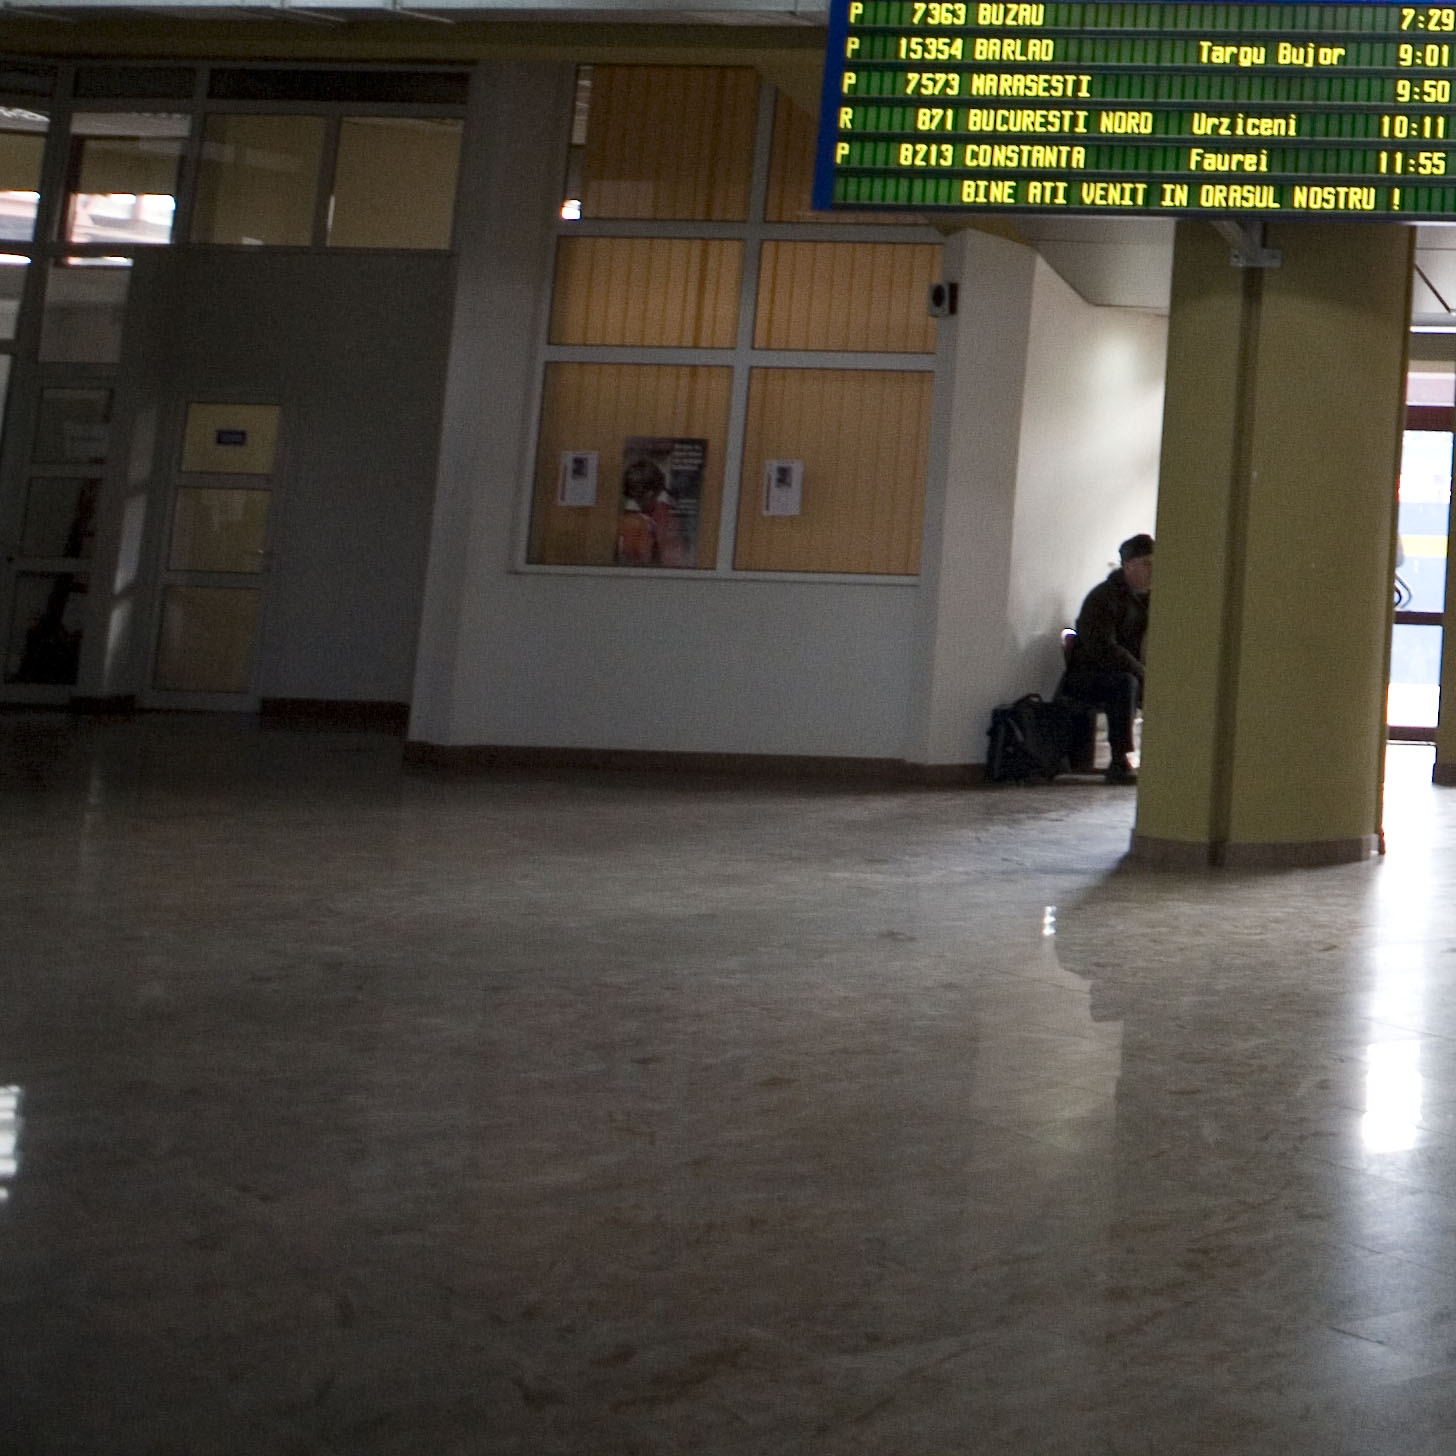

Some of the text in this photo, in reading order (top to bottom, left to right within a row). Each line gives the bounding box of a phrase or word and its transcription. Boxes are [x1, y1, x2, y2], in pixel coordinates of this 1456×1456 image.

[849, 2, 863, 23] P
[912, 2, 966, 25] 7363
[977, 2, 1045, 26] BUZAU
[1401, 8, 1455, 32] 7:29
[846, 37, 860, 58] P
[899, 37, 963, 60] 15354
[974, 38, 1054, 61] BARLAD
[1199, 40, 1266, 67] Targu
[1277, 42, 1346, 68] Bujor
[1399, 43, 1449, 67] 9:01
[842, 72, 857, 93] P
[905, 72, 960, 96] 7573
[971, 73, 1092, 98] MARASESTI
[1396, 79, 1451, 103] 9:50
[839, 107, 853, 129] R
[917, 108, 954, 131] 871
[967, 108, 1089, 133] BUCURESTI
[1099, 111, 1153, 134] NORD
[1192, 112, 1297, 137] Urziceni
[1382, 115, 1445, 139] 10:11
[836, 142, 850, 164] P
[899, 143, 954, 167] 8213
[964, 144, 1086, 169] CONSTANTA
[1189, 148, 1268, 172] Faurei
[1380, 150, 1446, 175] 11:55
[961, 180, 1017, 204] BINE
[1027, 181, 1068, 205] ATI
[1081, 182, 1147, 206] VENIT
[1161, 183, 1189, 207] IN
[1199, 184, 1281, 209] ORASUL
[1293, 185, 1376, 210] NOSTRU
